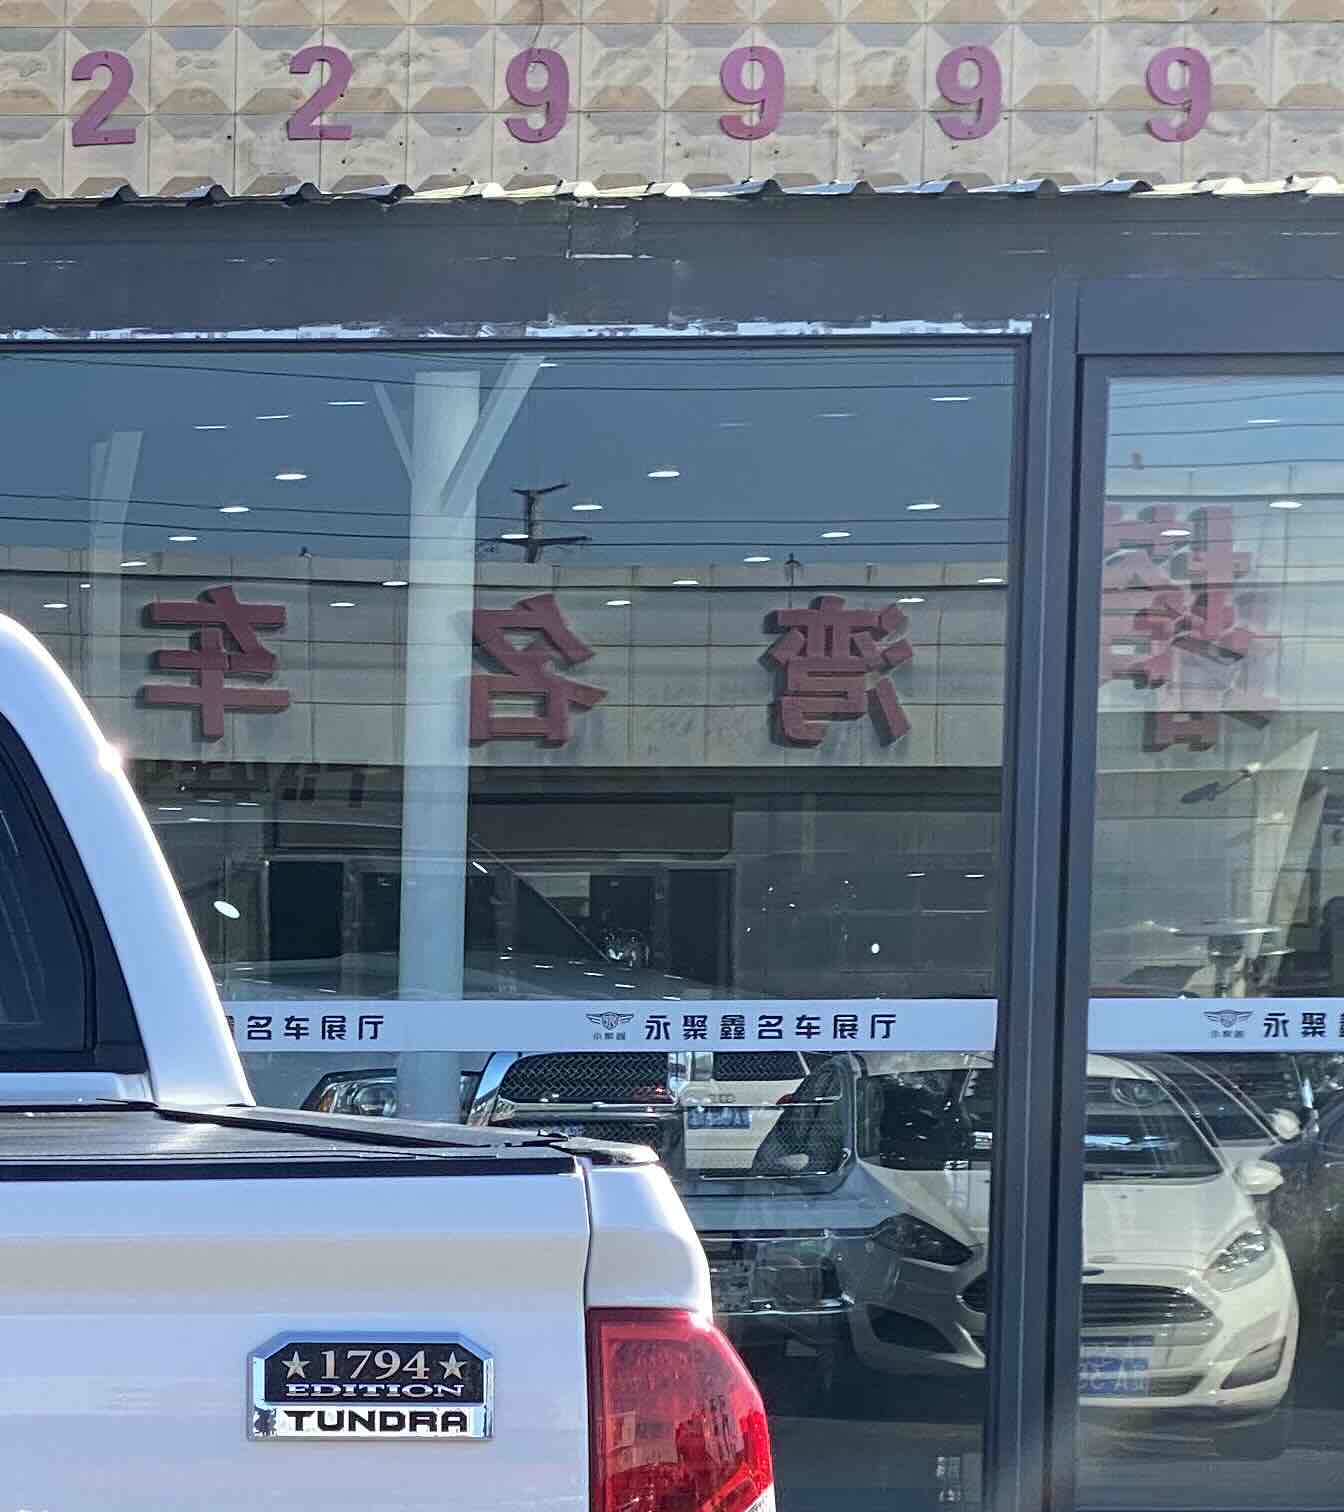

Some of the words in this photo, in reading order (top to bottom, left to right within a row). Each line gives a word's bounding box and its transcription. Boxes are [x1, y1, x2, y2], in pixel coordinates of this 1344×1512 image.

[226, 1015, 384, 1040] 名车展厅
[645, 1014, 897, 1041] 永聚鑫名车展厅
[1263, 1012, 1344, 1038] 永聚
[321, 1350, 430, 1380] 1794
[285, 1383, 465, 1398] EDITION
[283, 1410, 468, 1433] TUNDRA
